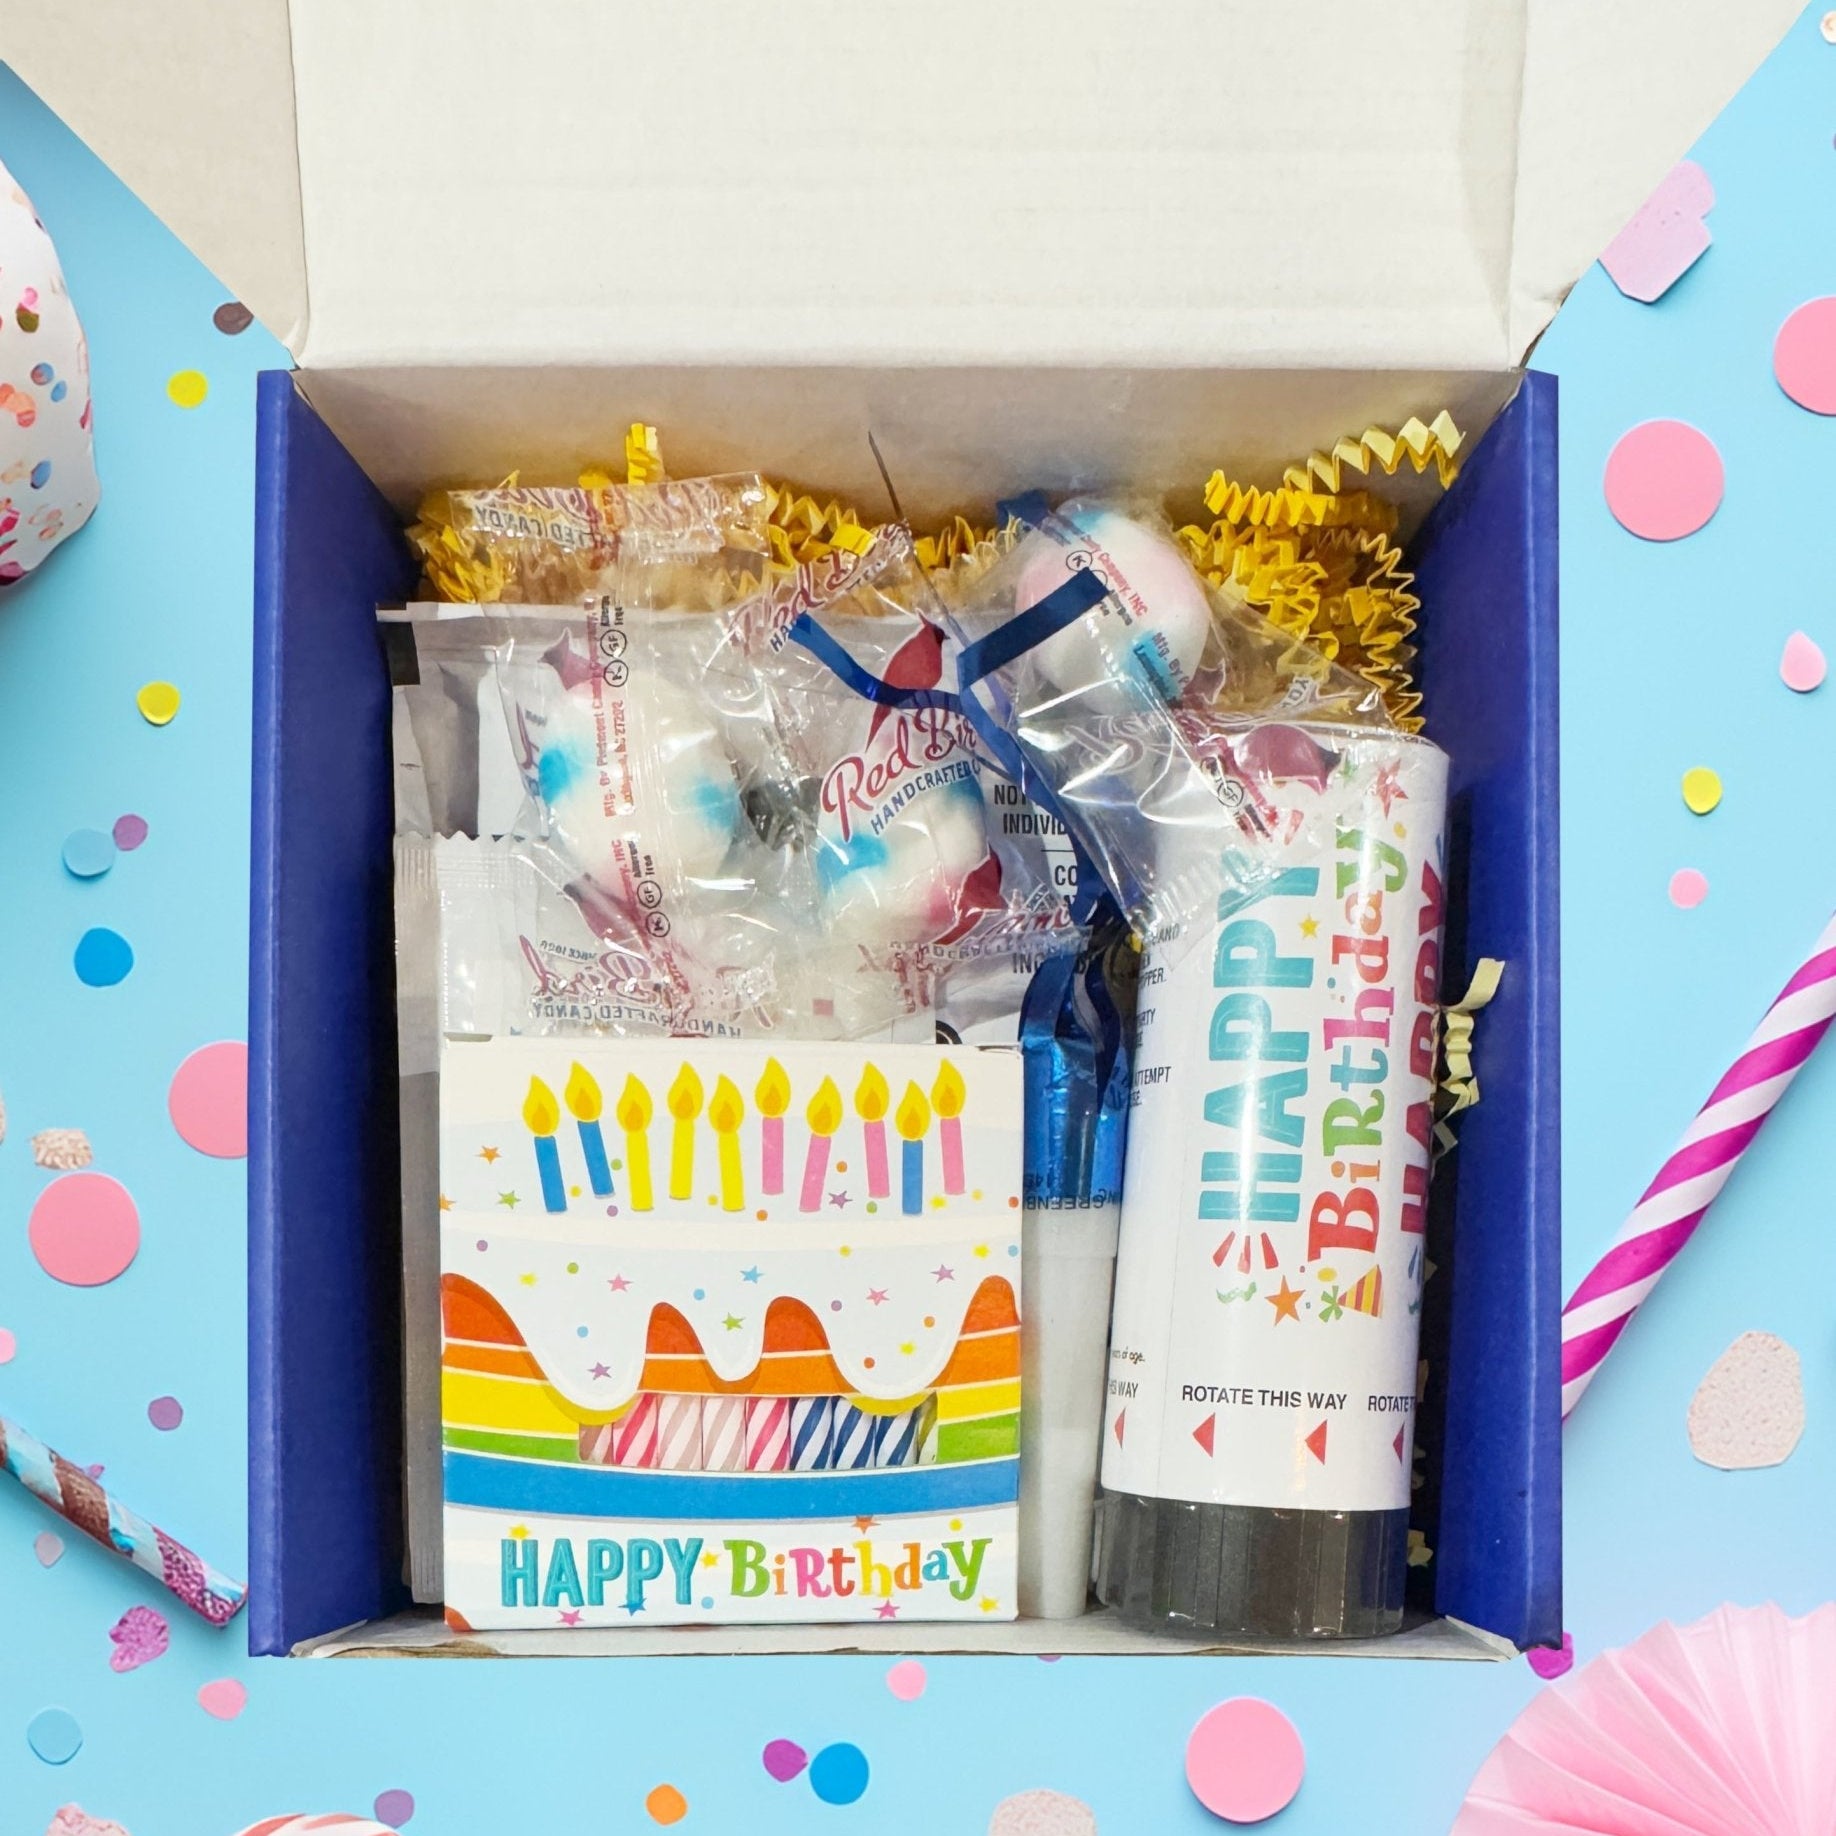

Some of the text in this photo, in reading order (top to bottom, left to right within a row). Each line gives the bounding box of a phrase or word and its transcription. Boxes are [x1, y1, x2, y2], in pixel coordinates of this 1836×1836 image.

[822, 713, 922, 843] Red
[912, 694, 978, 763] Bir
[870, 764, 977, 835] HANDCRAFTED
[1198, 847, 1320, 1222] HAPPY
[1118, 1380, 1139, 1399] WAY
[1182, 1385, 1348, 1410] ROTATE THIS WAY
[1367, 1395, 1409, 1412] ROTATE
[500, 1537, 704, 1608] HAPPY
